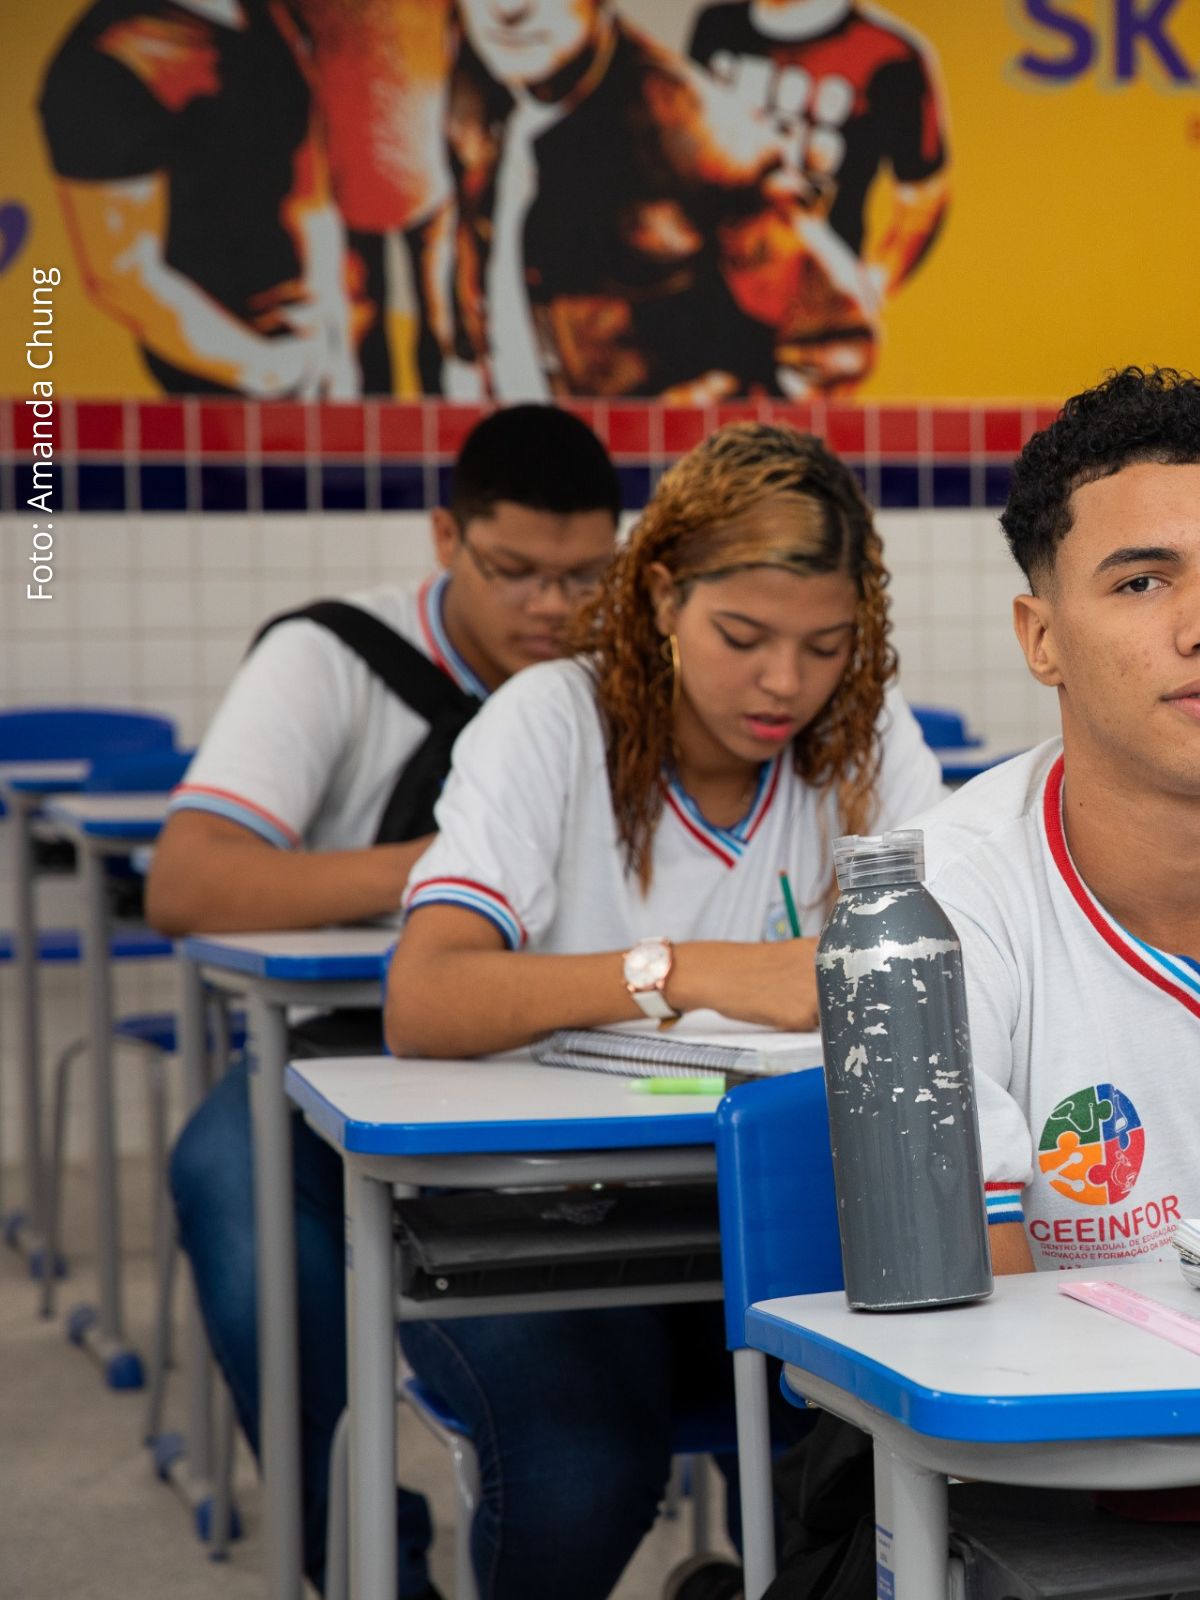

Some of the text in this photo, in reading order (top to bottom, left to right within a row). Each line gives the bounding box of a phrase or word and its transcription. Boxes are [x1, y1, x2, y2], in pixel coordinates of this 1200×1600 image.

[1029, 1195, 1181, 1243] CEEINFOR
[1041, 1242, 1077, 1251] CENTRO
[1079, 1243, 1126, 1251] ESTADUAL
[1129, 1239, 1140, 1247] DE
